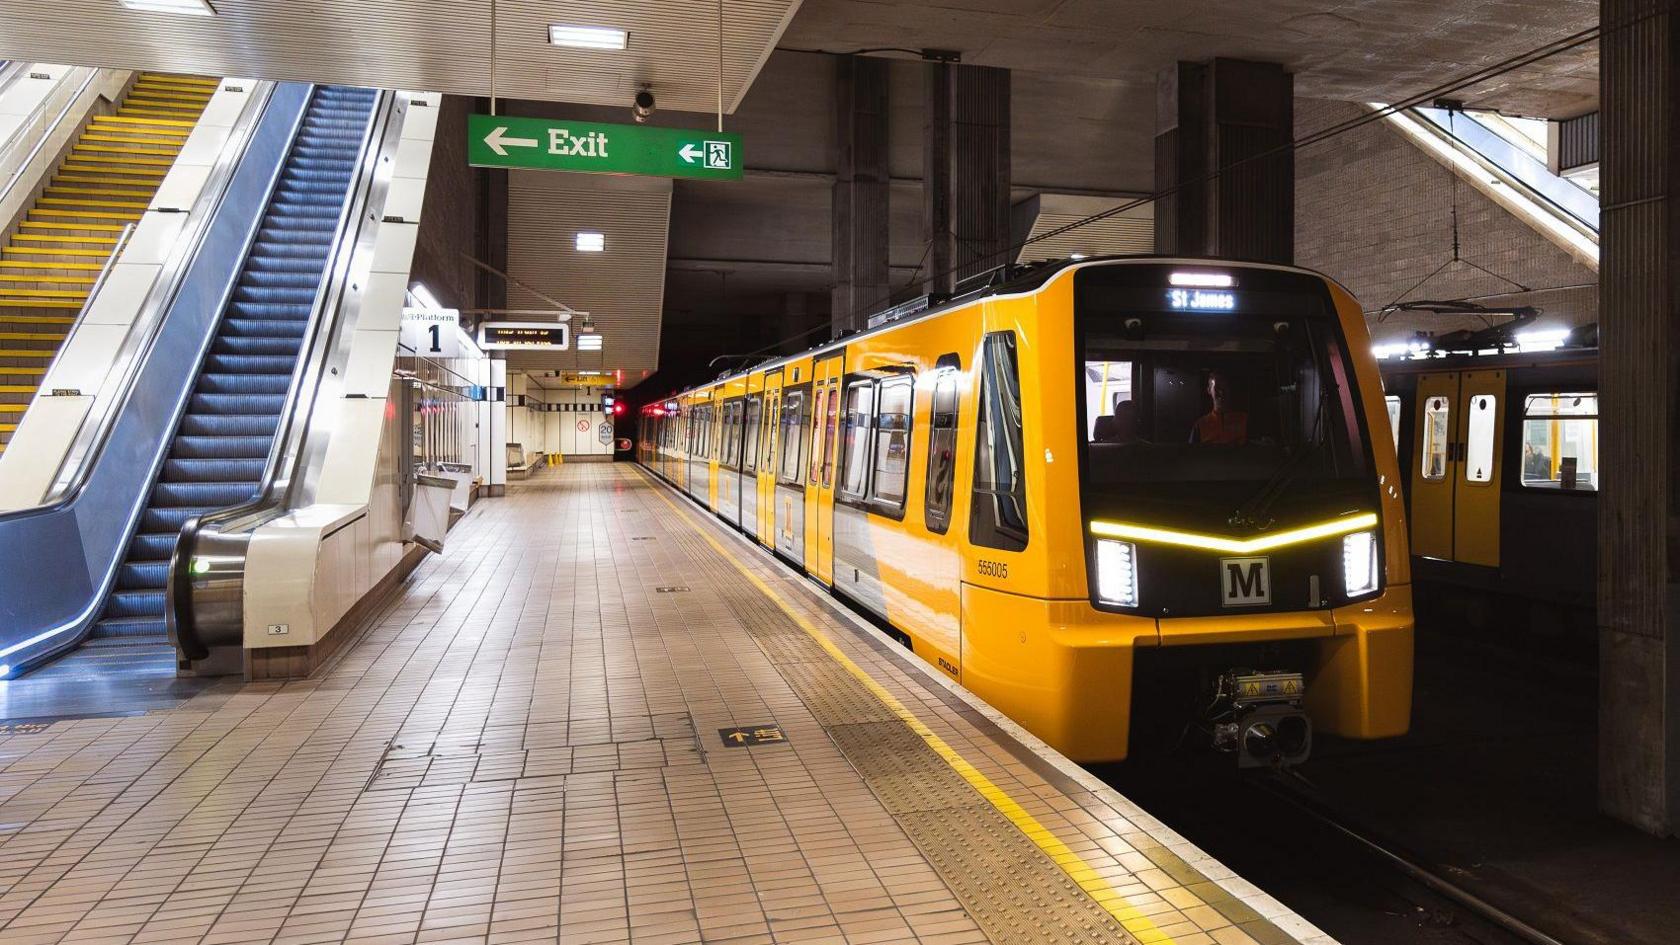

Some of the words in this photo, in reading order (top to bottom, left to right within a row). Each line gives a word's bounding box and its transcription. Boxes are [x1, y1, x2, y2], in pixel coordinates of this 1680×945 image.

[547, 128, 609, 158] Exit
[1172, 290, 1187, 308] St
[1190, 290, 1234, 309] James
[417, 313, 455, 322] Platform
[428, 324, 441, 352] 1
[600, 425, 613, 434] 20
[978, 559, 1008, 579] 555005
[1227, 563, 1265, 598] M
[275, 625, 282, 633] 3
